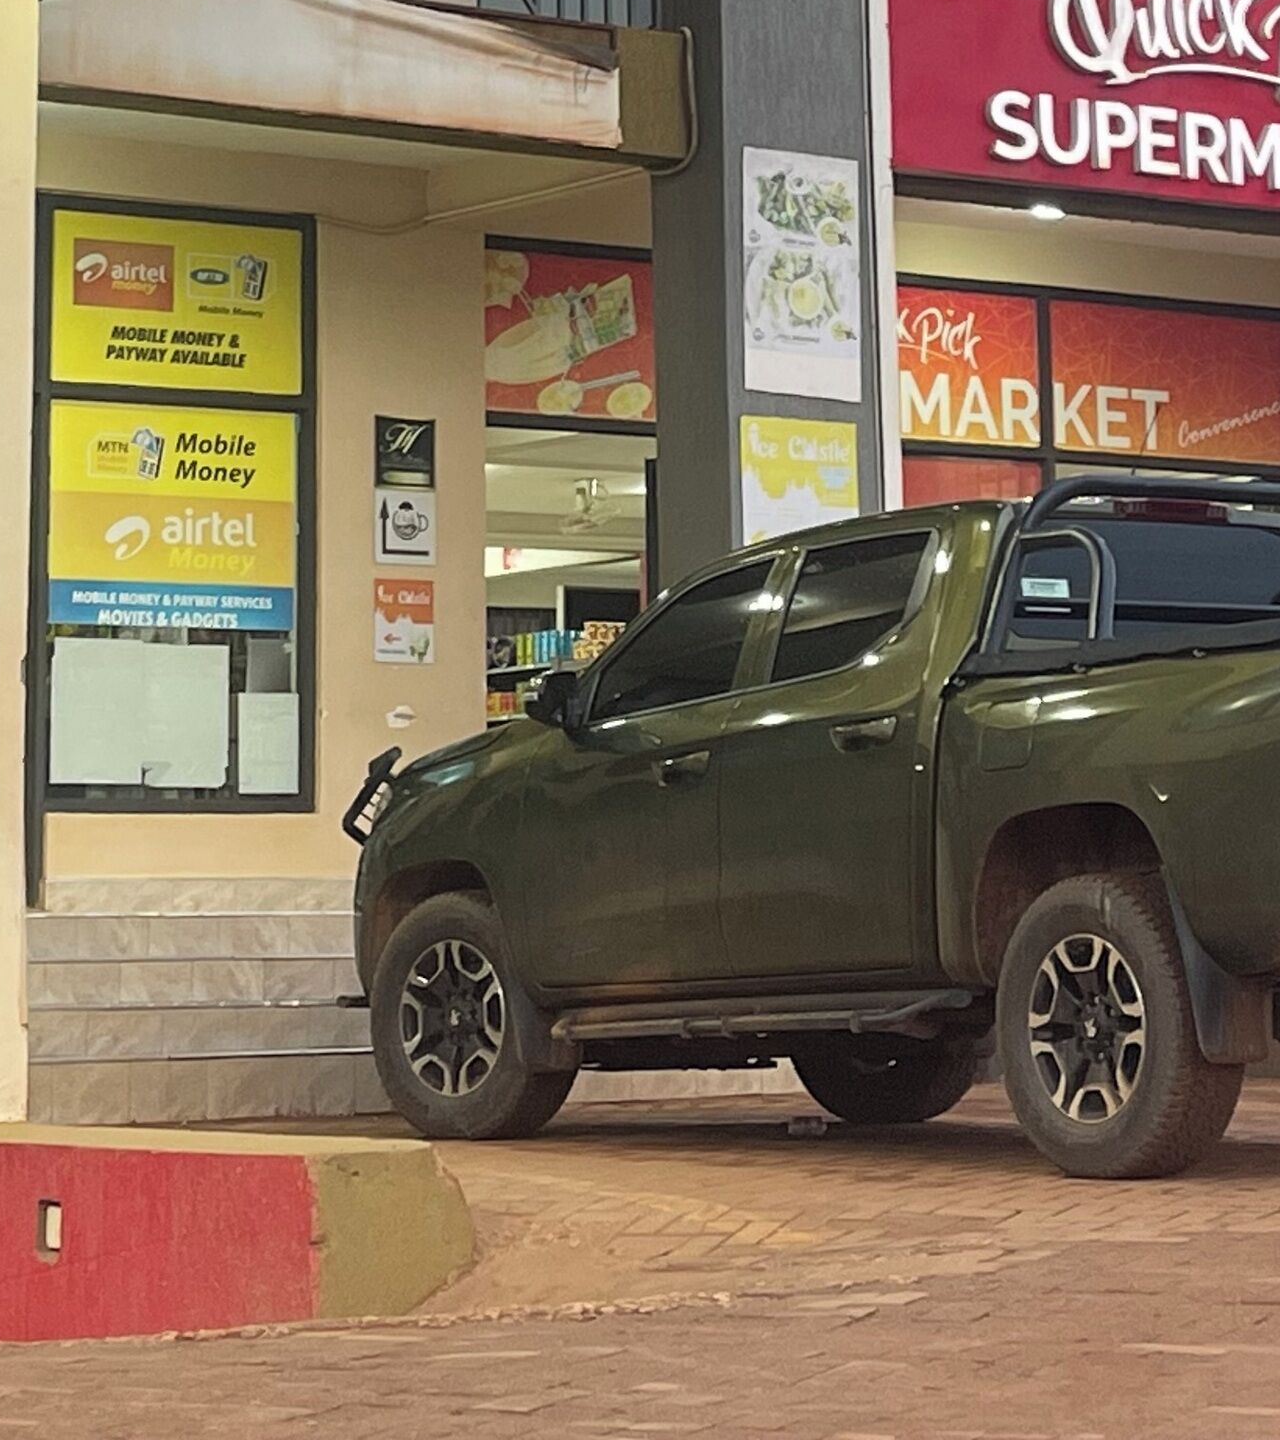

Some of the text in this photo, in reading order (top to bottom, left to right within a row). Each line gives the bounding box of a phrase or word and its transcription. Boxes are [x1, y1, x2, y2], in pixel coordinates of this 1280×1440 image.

[111, 261, 168, 284] airtel
[111, 326, 240, 348] MOBILE MONEY &
[912, 307, 982, 370] Pick
[106, 345, 247, 368] PAYWAY AVAILABLE
[97, 440, 129, 453] MTN
[175, 433, 257, 456] Mobile
[175, 460, 257, 488] Money
[161, 507, 258, 547] airtel
[169, 547, 257, 576] Money
[72, 591, 117, 606] MOBILE
[119, 594, 160, 607] MONEY
[173, 596, 219, 609] PAYWAY
[221, 598, 273, 610] SERVICES
[97, 610, 239, 629] MOVIES & GADGETS
